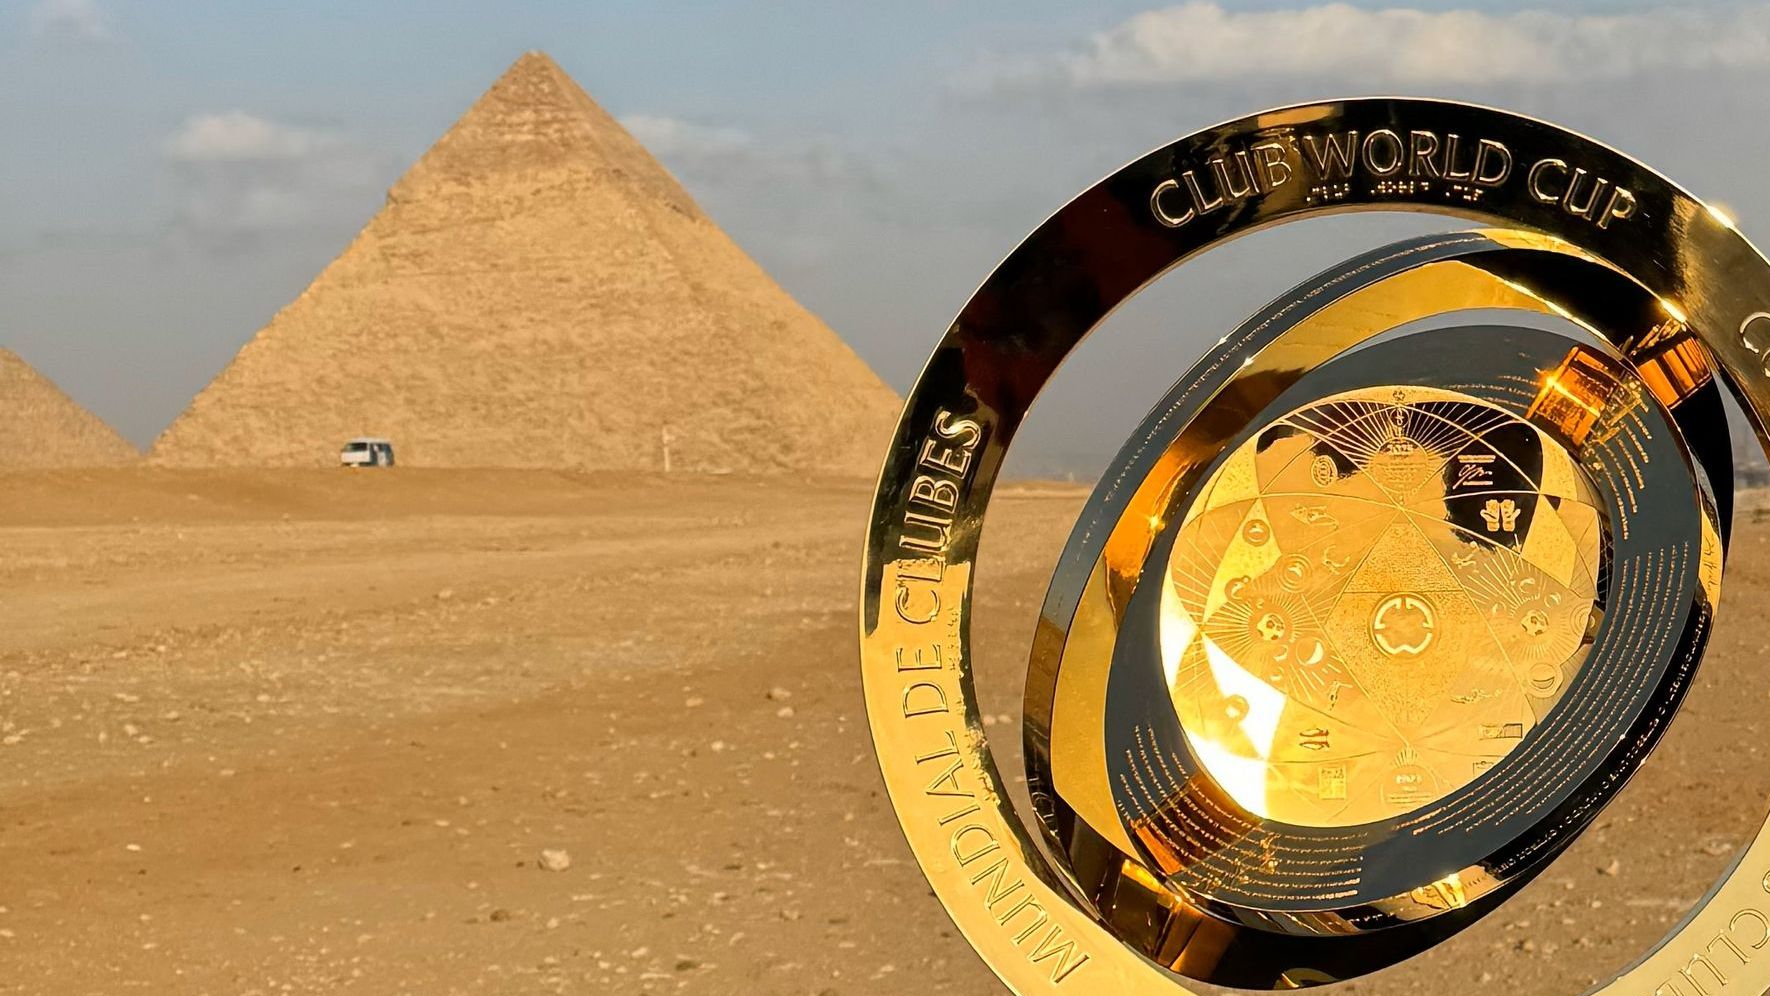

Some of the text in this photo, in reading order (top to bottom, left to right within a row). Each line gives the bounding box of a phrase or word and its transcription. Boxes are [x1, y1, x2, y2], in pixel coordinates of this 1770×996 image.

[1150, 129, 1636, 230] CLUB WORLD CUP
[895, 409, 1090, 984] MUNDIAL DE CLUBES
